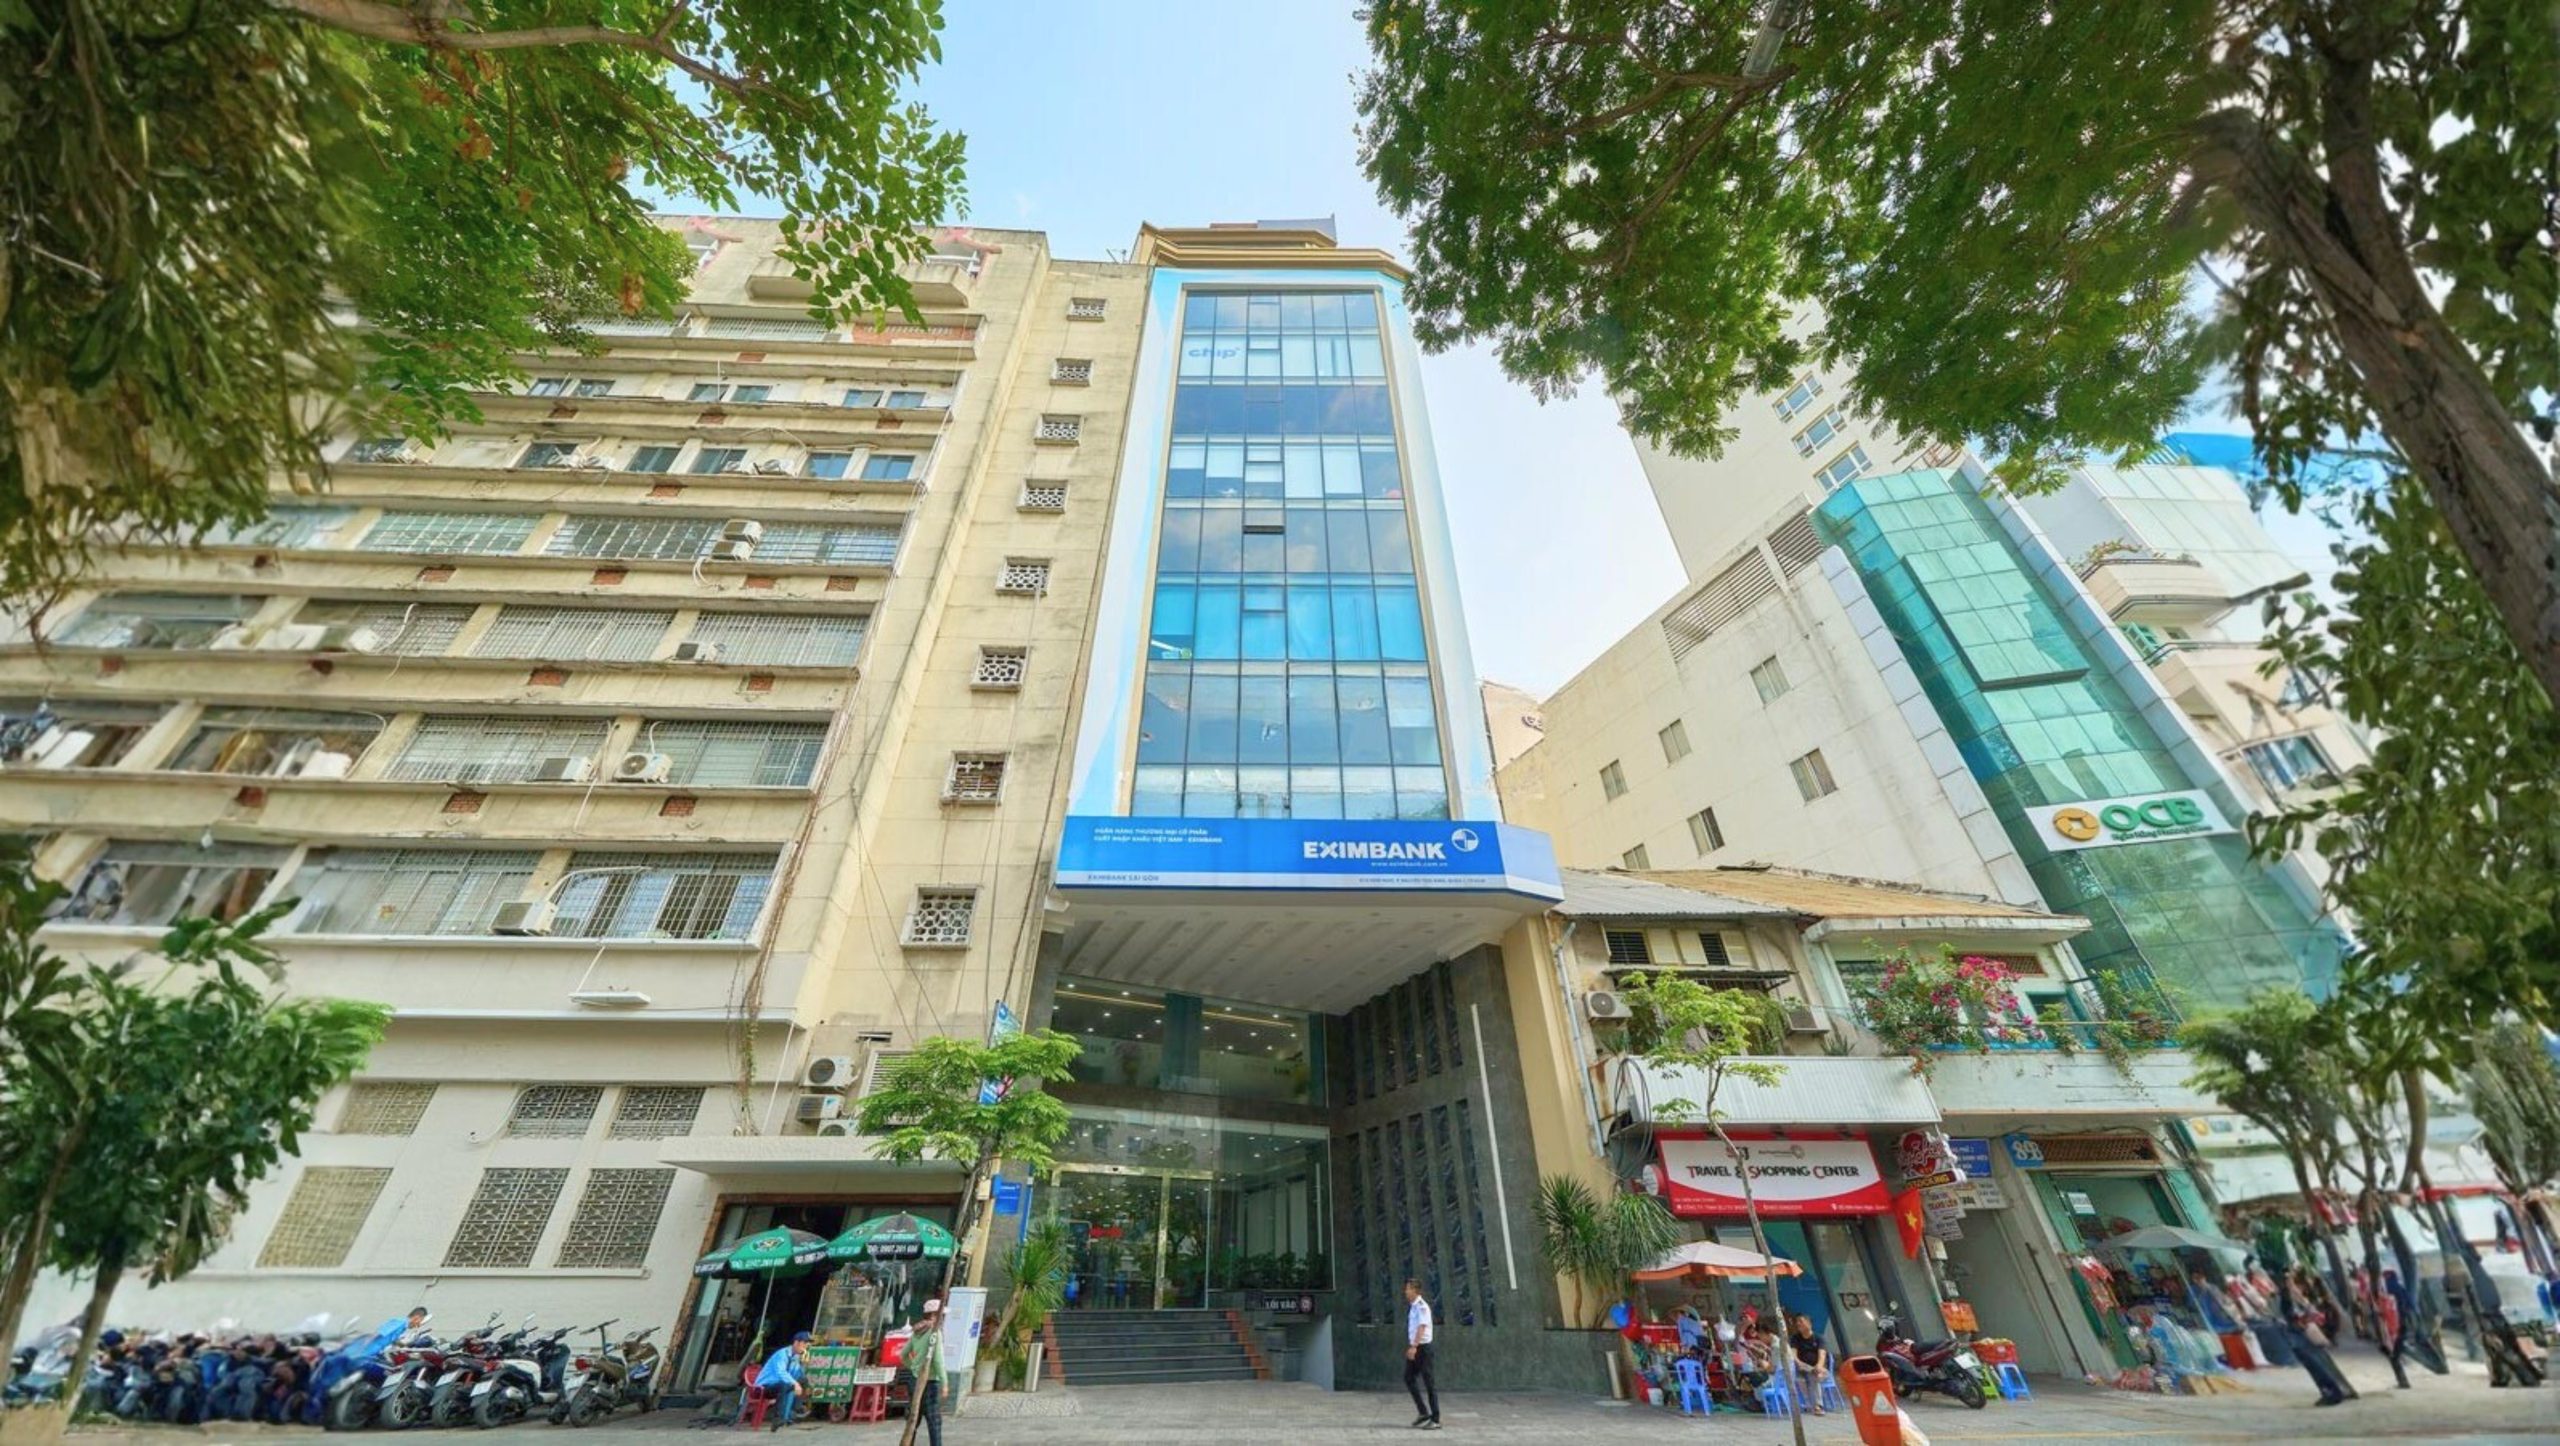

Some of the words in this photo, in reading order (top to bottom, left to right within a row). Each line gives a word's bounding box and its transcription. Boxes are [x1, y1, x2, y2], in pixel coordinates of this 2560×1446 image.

[2100, 797, 2204, 832] OCB
[1303, 841, 1447, 860] EXIMBANK
[1686, 1165, 1732, 1178] TRAVEL
[1748, 1165, 1811, 1179] SHOPPING
[1813, 1165, 1860, 1179] CENTER
